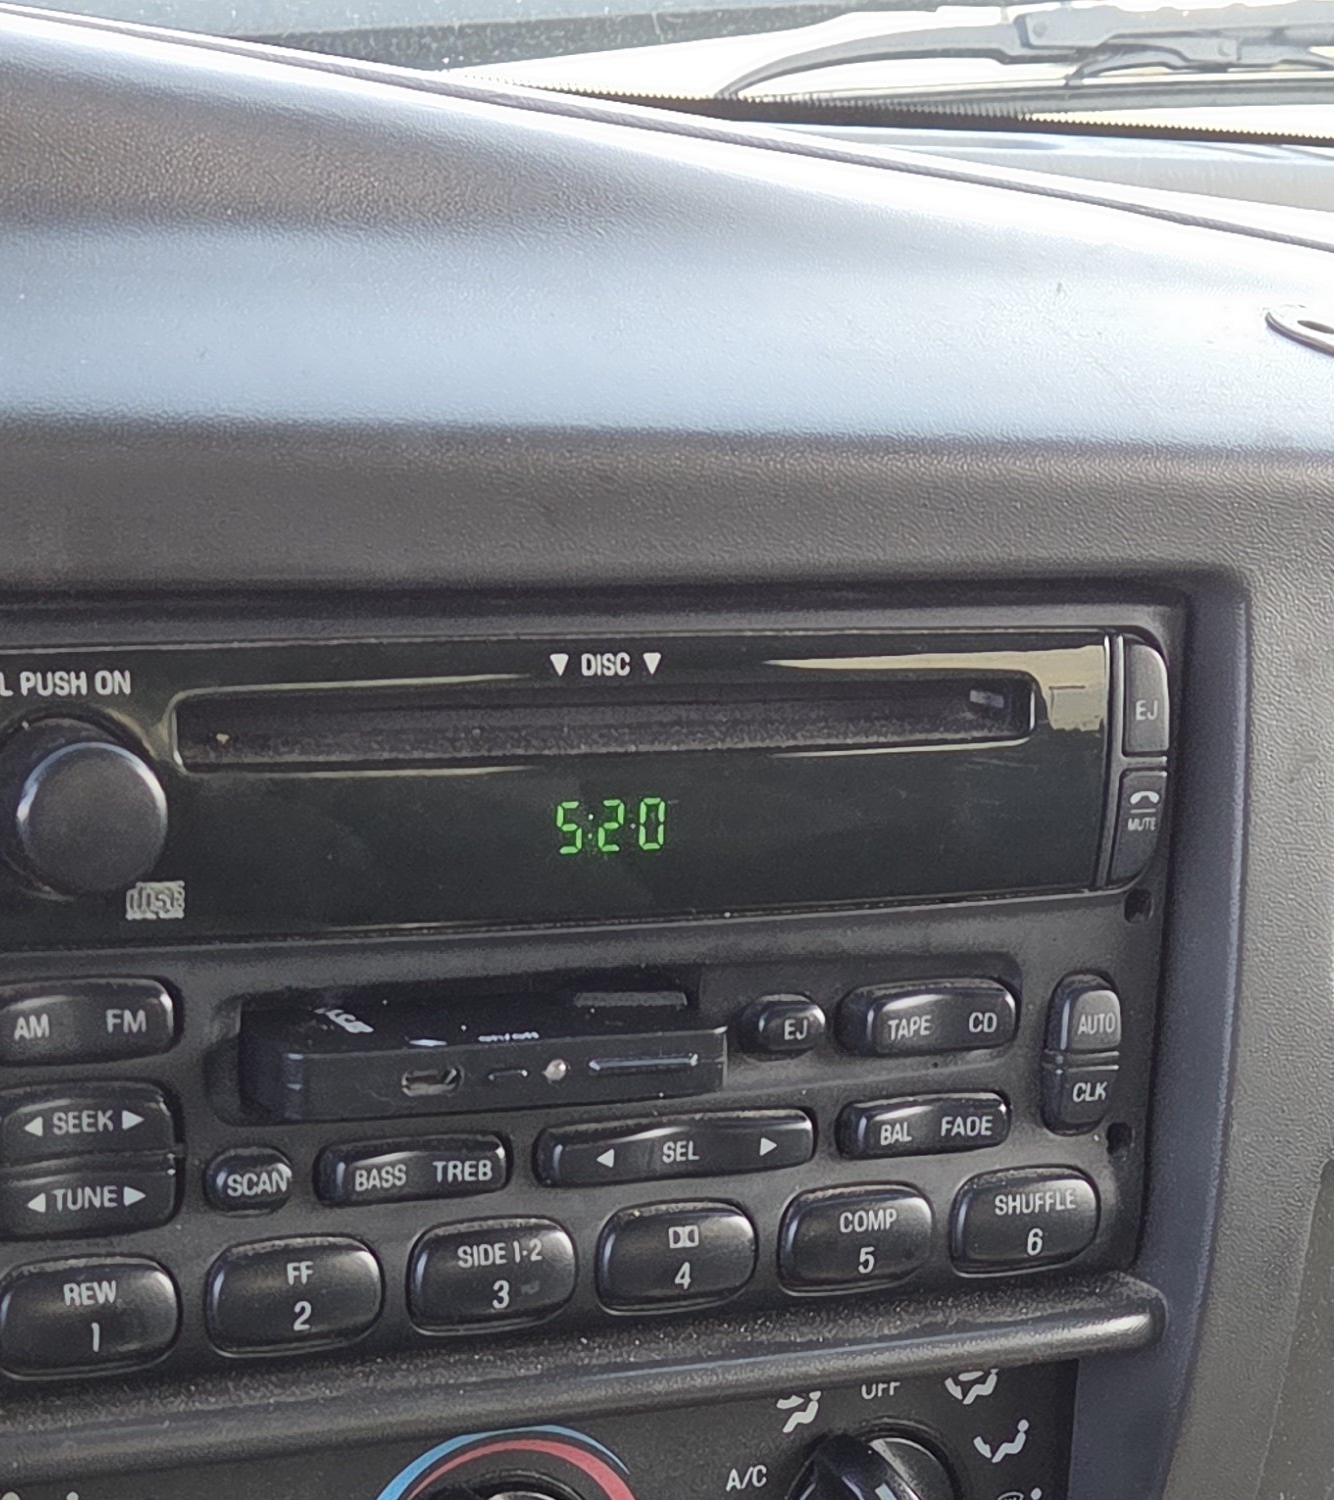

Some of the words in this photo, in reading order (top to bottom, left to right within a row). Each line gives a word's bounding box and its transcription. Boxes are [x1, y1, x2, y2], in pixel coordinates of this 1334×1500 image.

[581, 653, 631, 676] DISC
[20, 671, 88, 696] PUSH
[94, 670, 131, 694] ON
[1135, 700, 1159, 721] EJ
[556, 798, 666, 854] 5:20
[1127, 817, 1157, 832] MUTE
[13, 1016, 50, 1041] AM
[106, 1010, 147, 1034] FM
[784, 1020, 808, 1041] EJ
[888, 1016, 932, 1041] TAPE
[968, 1012, 998, 1034] CD
[1077, 1012, 1116, 1035] AUTO
[1072, 1082, 1108, 1104] CLK
[52, 1110, 114, 1135] SEEK
[880, 1123, 912, 1146] BAL
[940, 1116, 994, 1139] FADE
[662, 1141, 700, 1163] SEL
[227, 1172, 289, 1198] SCAN
[354, 1165, 407, 1191] BASS
[432, 1161, 493, 1184] TREB
[53, 1185, 118, 1212] TUNE
[994, 1190, 1077, 1218] SHUFFLE
[839, 1209, 898, 1234] COMP
[1026, 1227, 1043, 1256] 6
[457, 1242, 507, 1268] SIDE
[858, 1246, 875, 1275] 5
[287, 1262, 314, 1285] FF
[674, 1262, 692, 1290] 4
[63, 1281, 118, 1306] REW
[492, 1280, 510, 1309] 3
[294, 1303, 312, 1330] 2
[91, 1324, 100, 1352] 1
[725, 1466, 768, 1492] A/C
